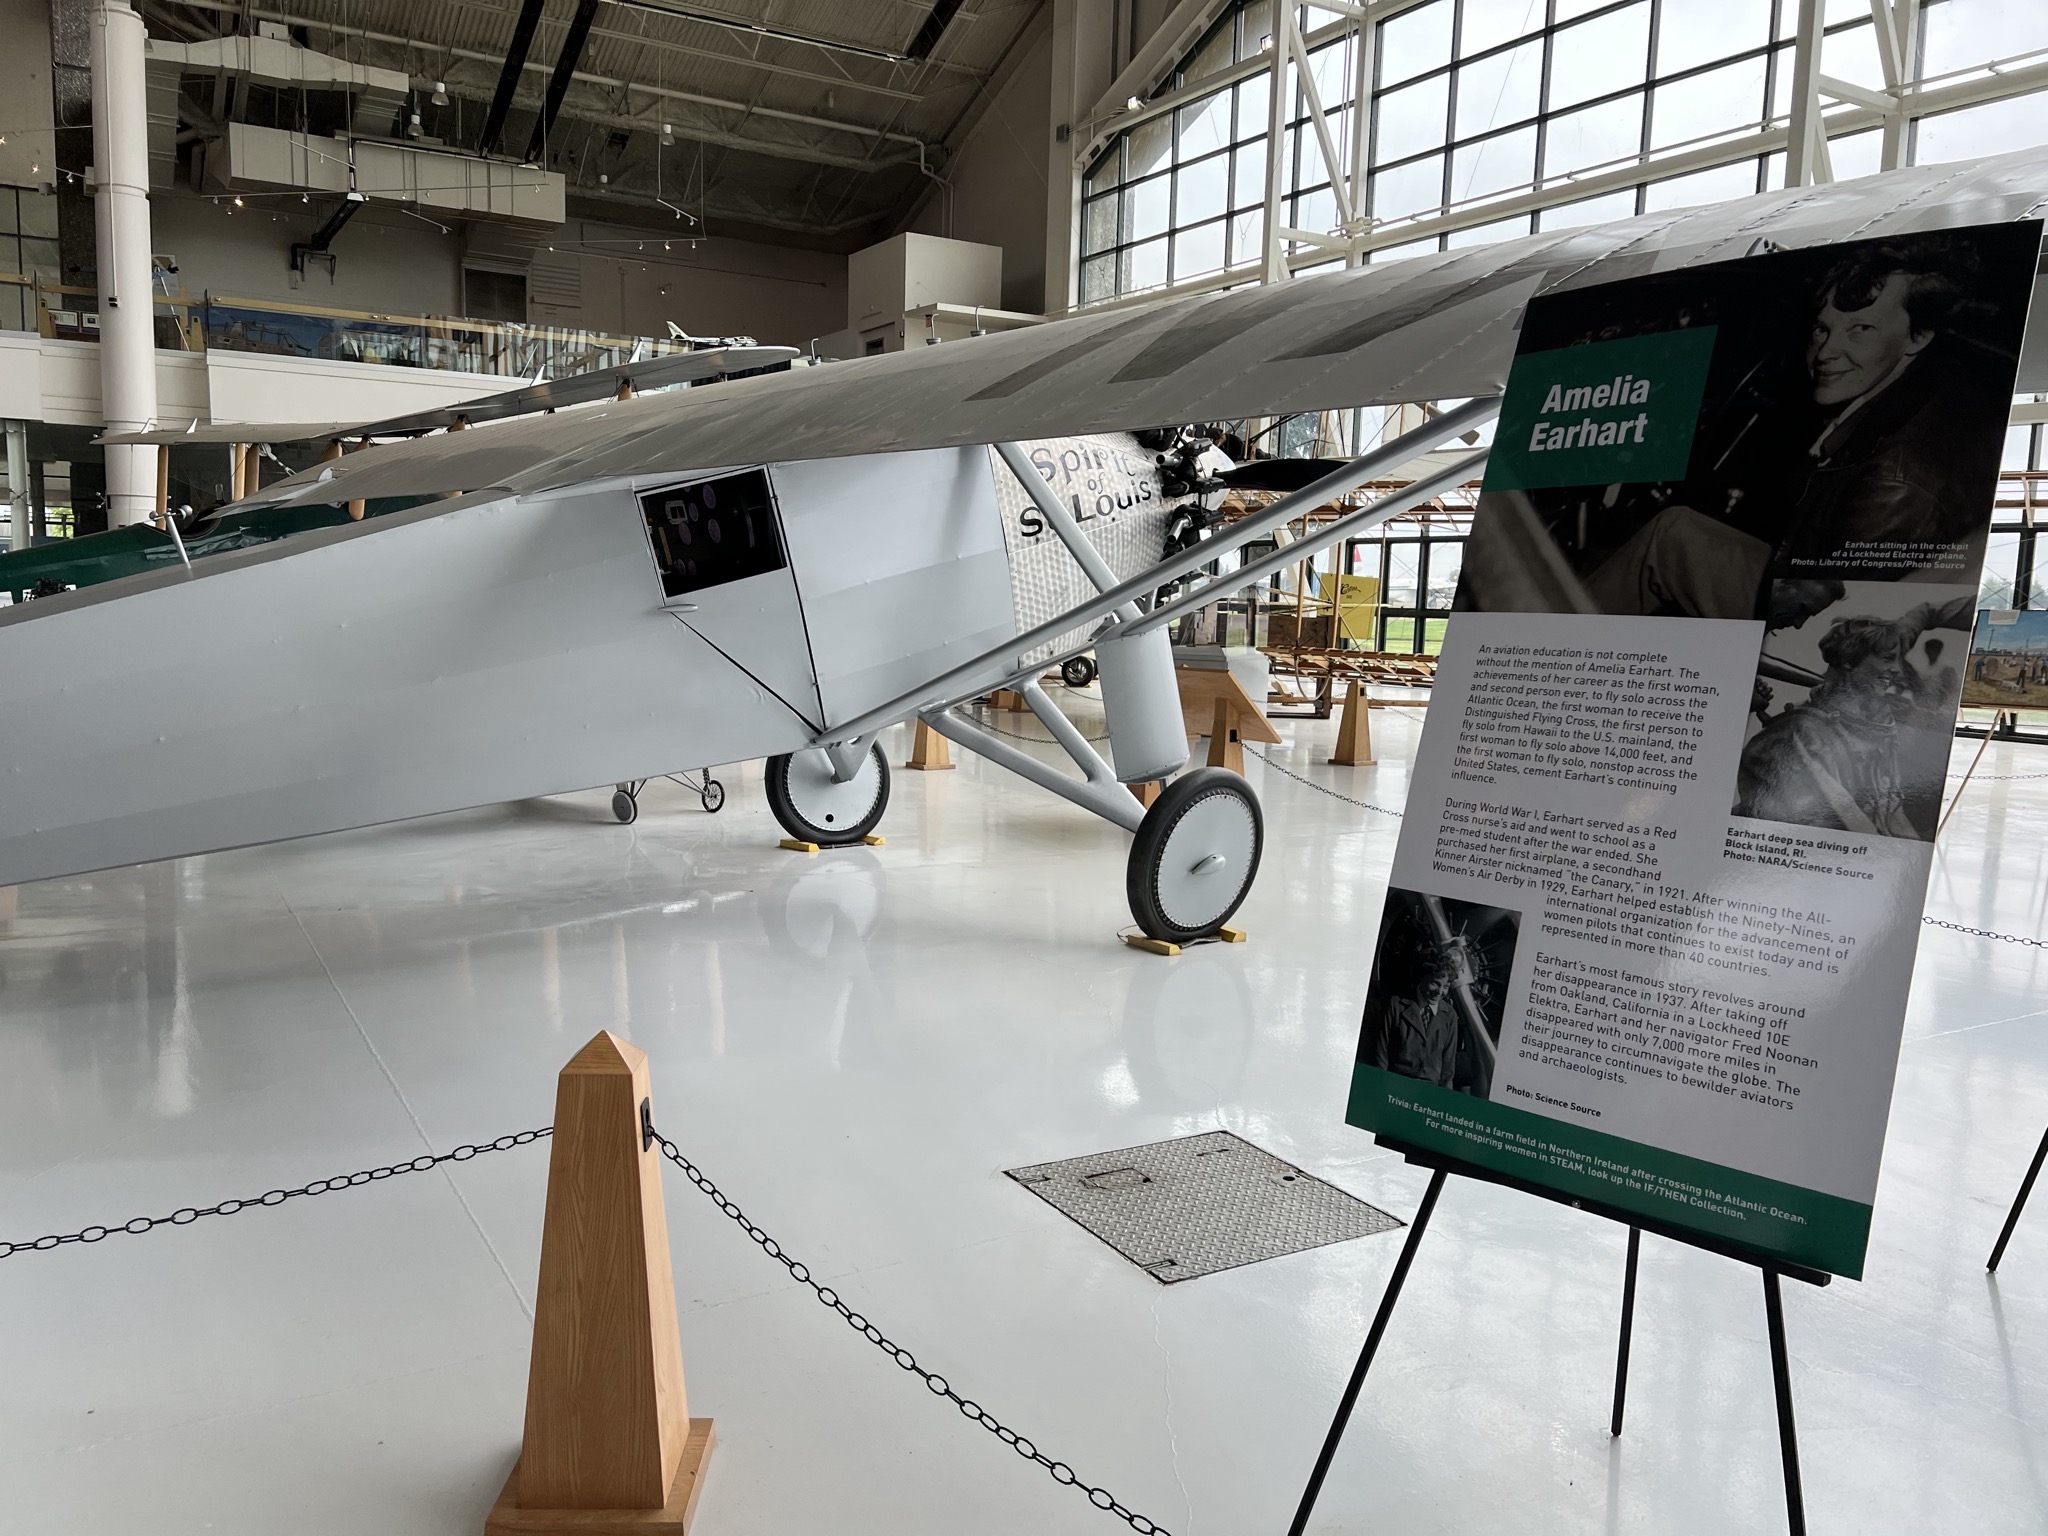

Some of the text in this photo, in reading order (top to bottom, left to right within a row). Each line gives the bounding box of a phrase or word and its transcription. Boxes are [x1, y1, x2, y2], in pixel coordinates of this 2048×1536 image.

[1540, 374, 1650, 414] Amelia
[1528, 412, 1648, 452] Earhart
[1029, 443, 1136, 485] Spirit
[1087, 472, 1105, 494] of
[1019, 480, 1152, 537] S Louis
[1818, 558, 1850, 567] Library
[1861, 559, 1932, 568] Congress/Photo
[1934, 561, 1965, 569] Source
[1844, 540, 1877, 548] Earhart
[1879, 542, 1907, 550] sitting
[1936, 542, 1968, 551] cockpit
[1849, 550, 1891, 558] Lockheed
[1926, 552, 1966, 560] airplane.
[1476, 657, 1700, 679] without the mention of Amelia Earhart. The
[1478, 644, 1668, 664] An aviation education is not complete
[1470, 682, 1708, 709] and second person ever, to fly solo across the
[1472, 669, 1719, 697] achievements of her career as the first woman,
[1466, 694, 1704, 723] Atlantic Ocean, the first woman to receive the
[1454, 756, 1485, 769] United
[1486, 760, 1520, 775] States,
[1522, 767, 1562, 778] cement
[1617, 778, 1677, 795] continuing
[1436, 837, 1662, 881] purchased her first airplane, a secondhand
[1439, 825, 1658, 866] pre-med student after the war ended. She
[1725, 838, 1806, 858] Block Island, RI.
[1727, 827, 1868, 855] Earhart deep sea diving off
[1723, 849, 1874, 880] Photo: NARA/Science Source
[1541, 924, 1771, 977] represented in more than 40 countries.
[1533, 965, 1788, 1030] her disappearance in 1937. After taking off
[1589, 966, 1618, 979] most
[1621, 970, 1664, 989] famous
[1668, 982, 1699, 998] story
[1702, 989, 1754, 1008] revolves
[1757, 1001, 1806, 1018] around
[1528, 992, 1818, 1068] Elektra, Earhart and her navigator Fred Noonan
[1518, 1049, 1627, 1084] and archaeologists.
[1521, 1034, 1793, 1110] disappearance continues to bewilder aviators
[1506, 1084, 1601, 1117] Photo: Science Source
[1387, 1094, 1411, 1109] Trivia:
[1413, 1102, 1444, 1119] Earhart
[1445, 1112, 1474, 1128] landed
[1475, 1123, 1484, 1131] in
[1492, 1126, 1514, 1139] farm
[1516, 1133, 1536, 1147] field
[1538, 1142, 1546, 1150] in
[1548, 1143, 1592, 1163] Northern
[1594, 1156, 1629, 1173] Ireland
[1631, 1168, 1656, 1181] after
[1658, 1177, 1702, 1196] crossing
[1704, 1188, 1722, 1200] the
[1723, 1194, 1767, 1213] Atlantic
[1769, 1207, 1807, 1225] Ocean.
[1425, 1117, 1746, 1220] For more inspiring women in STEAM, look up the IF/THEN Collection.
